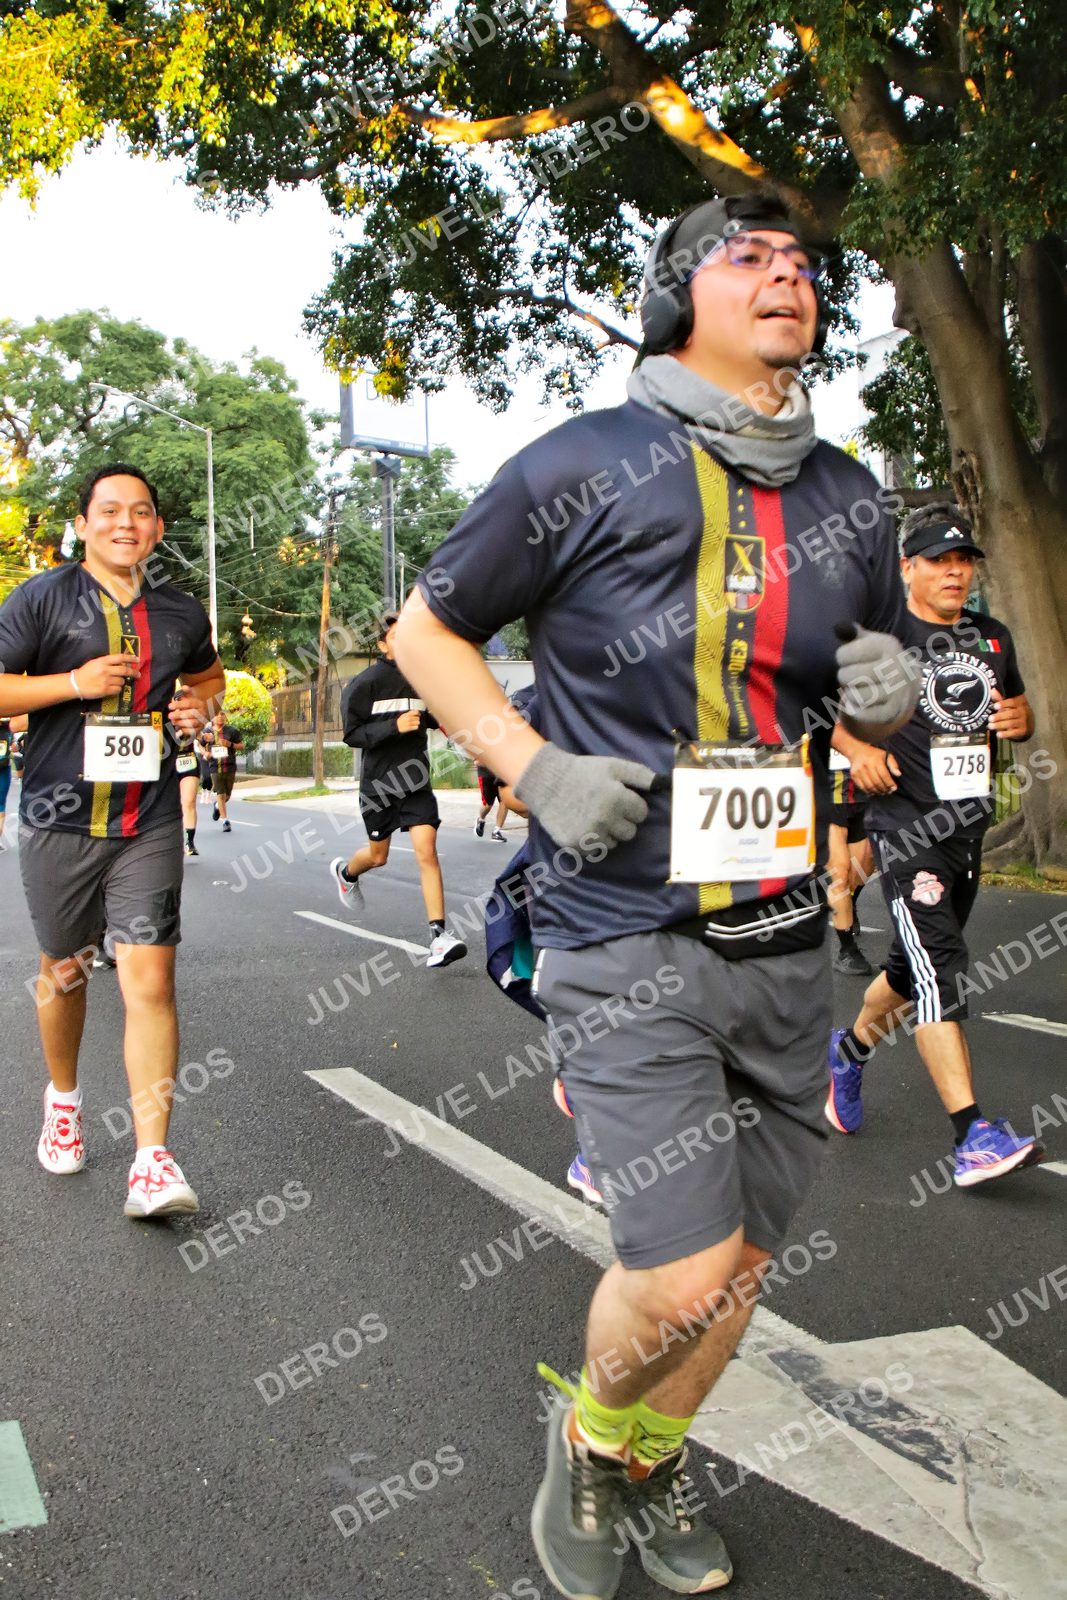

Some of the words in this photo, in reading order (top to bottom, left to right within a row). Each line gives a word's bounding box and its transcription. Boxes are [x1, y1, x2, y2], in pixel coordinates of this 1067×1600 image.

[104, 735, 145, 757] 580
[943, 753, 986, 776] 2758
[699, 786, 796, 830] 7009
